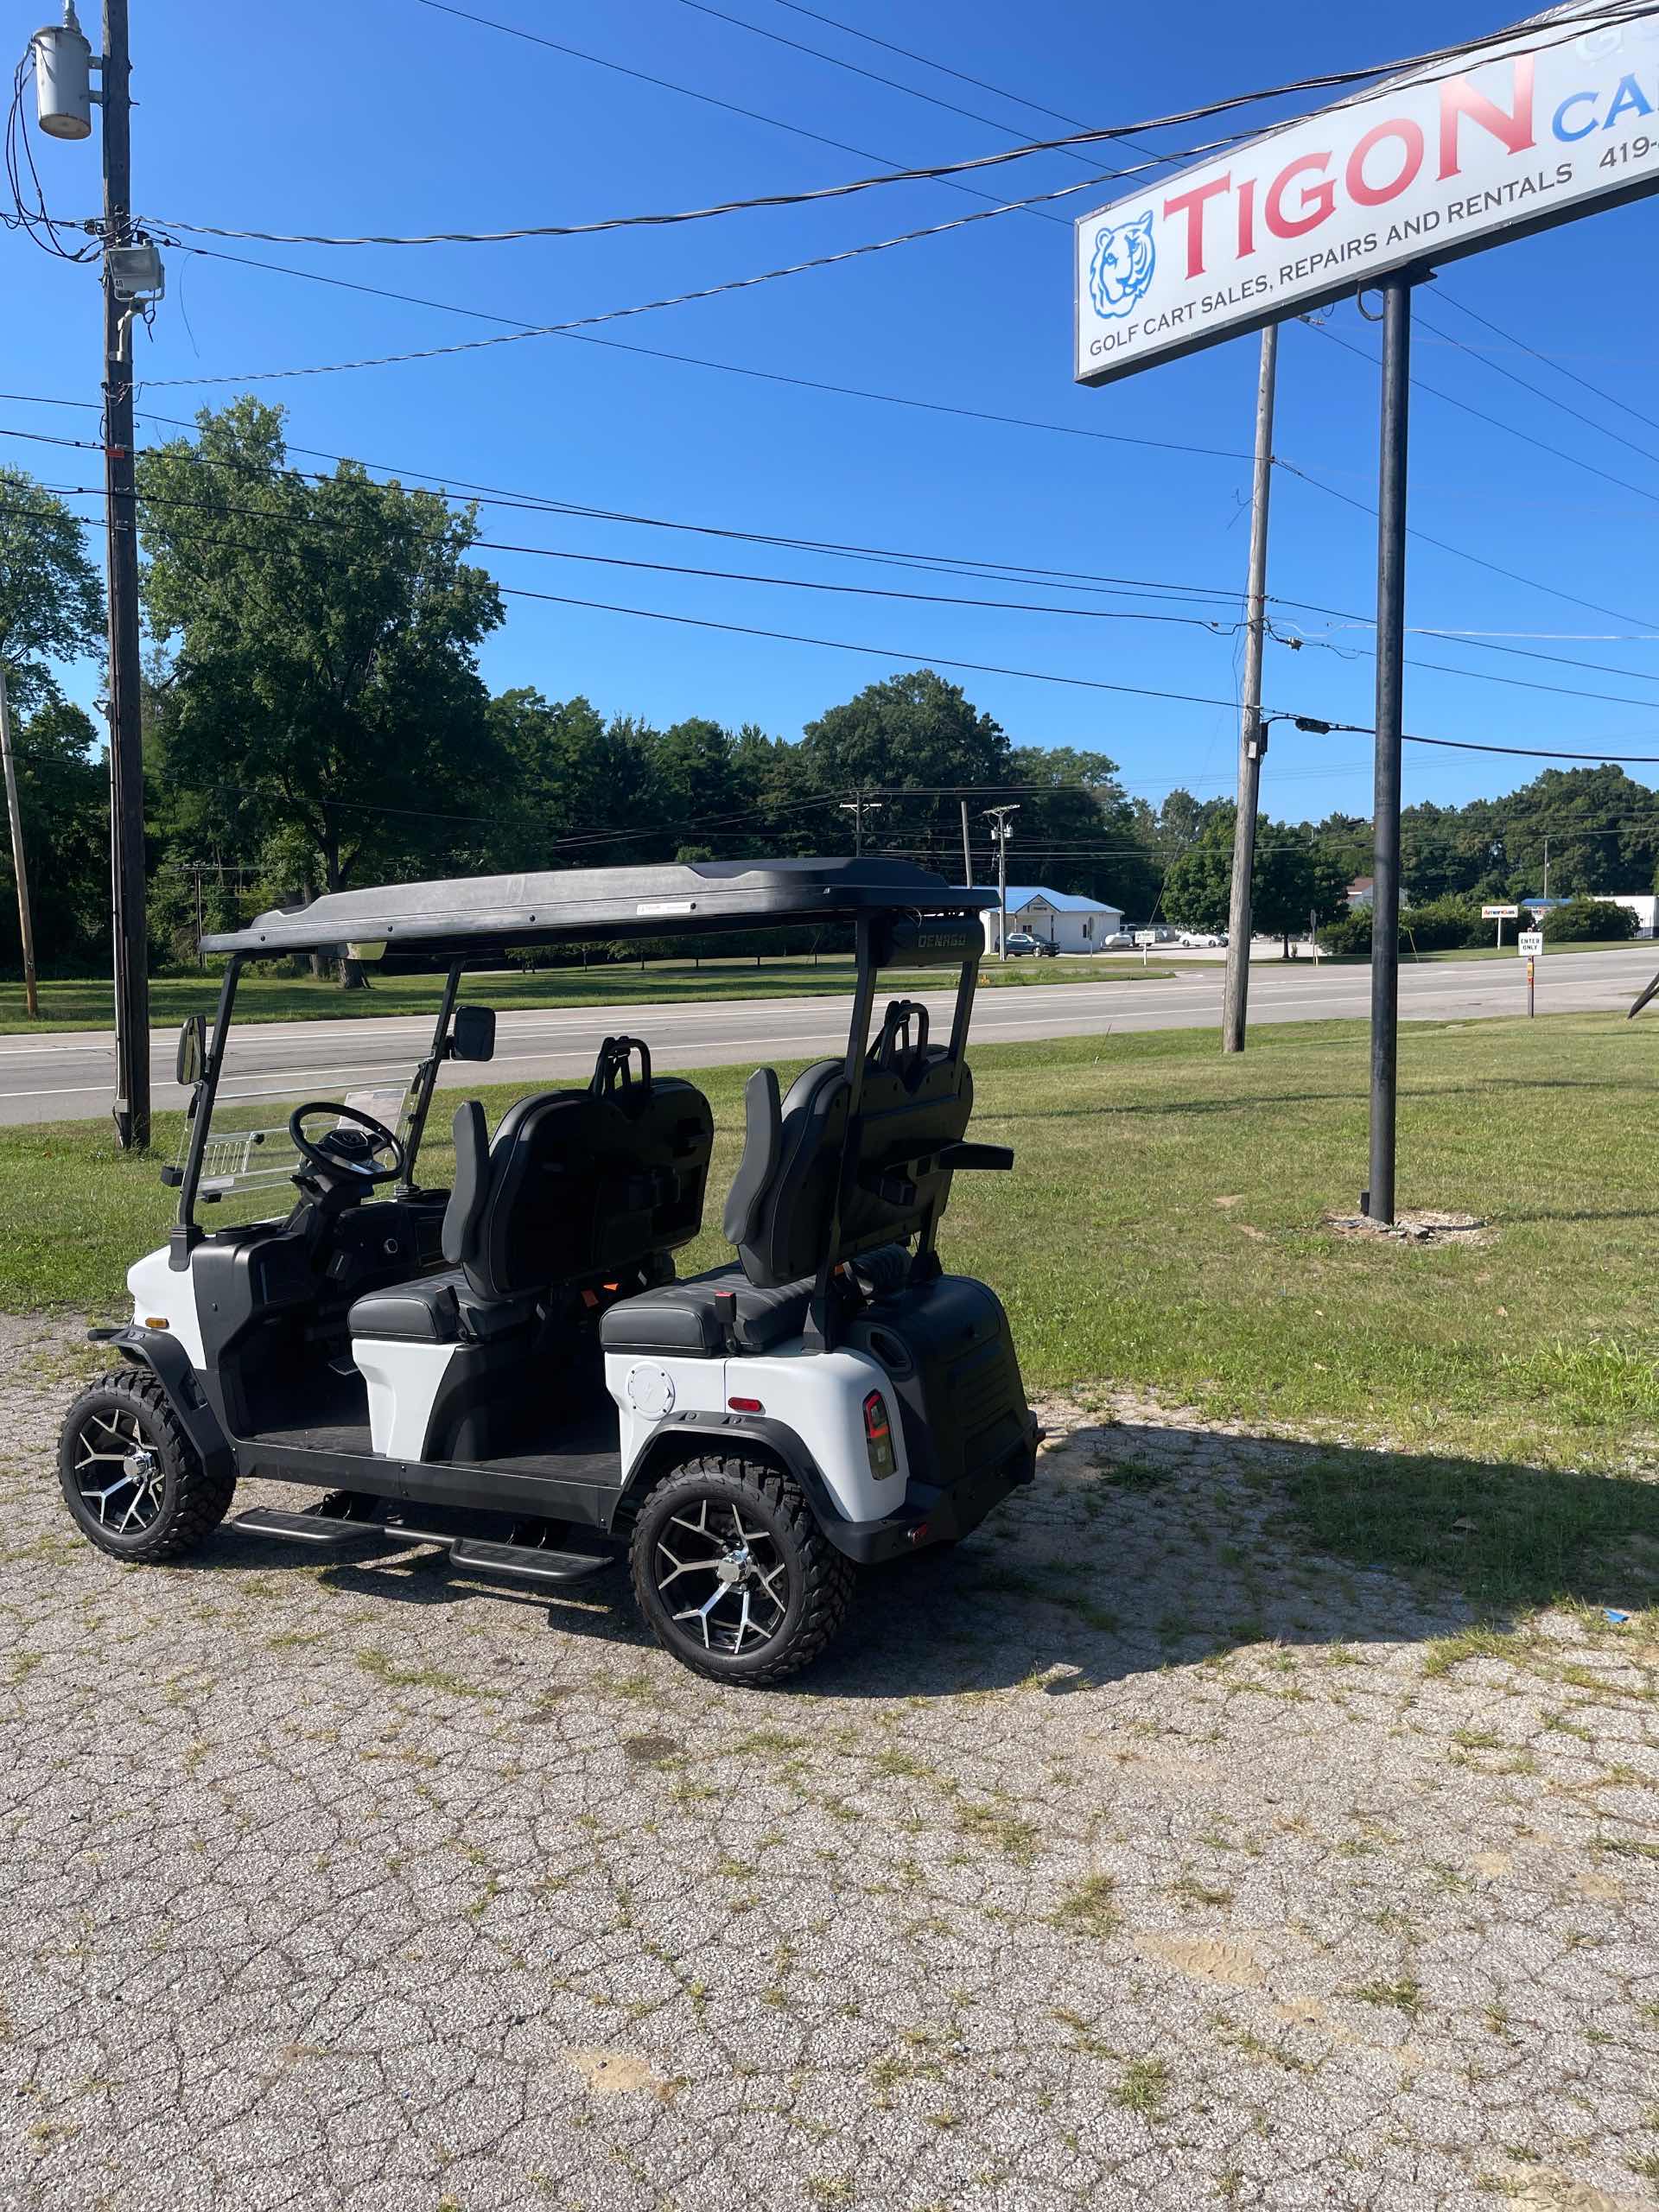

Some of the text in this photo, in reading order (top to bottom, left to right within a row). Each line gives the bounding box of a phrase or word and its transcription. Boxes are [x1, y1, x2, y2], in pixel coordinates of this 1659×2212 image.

[1090, 136, 1659, 356] GOLF CART SALES, REPAIRS AND RENTALS 419-
[1163, 52, 1659, 281] TIGON CA
